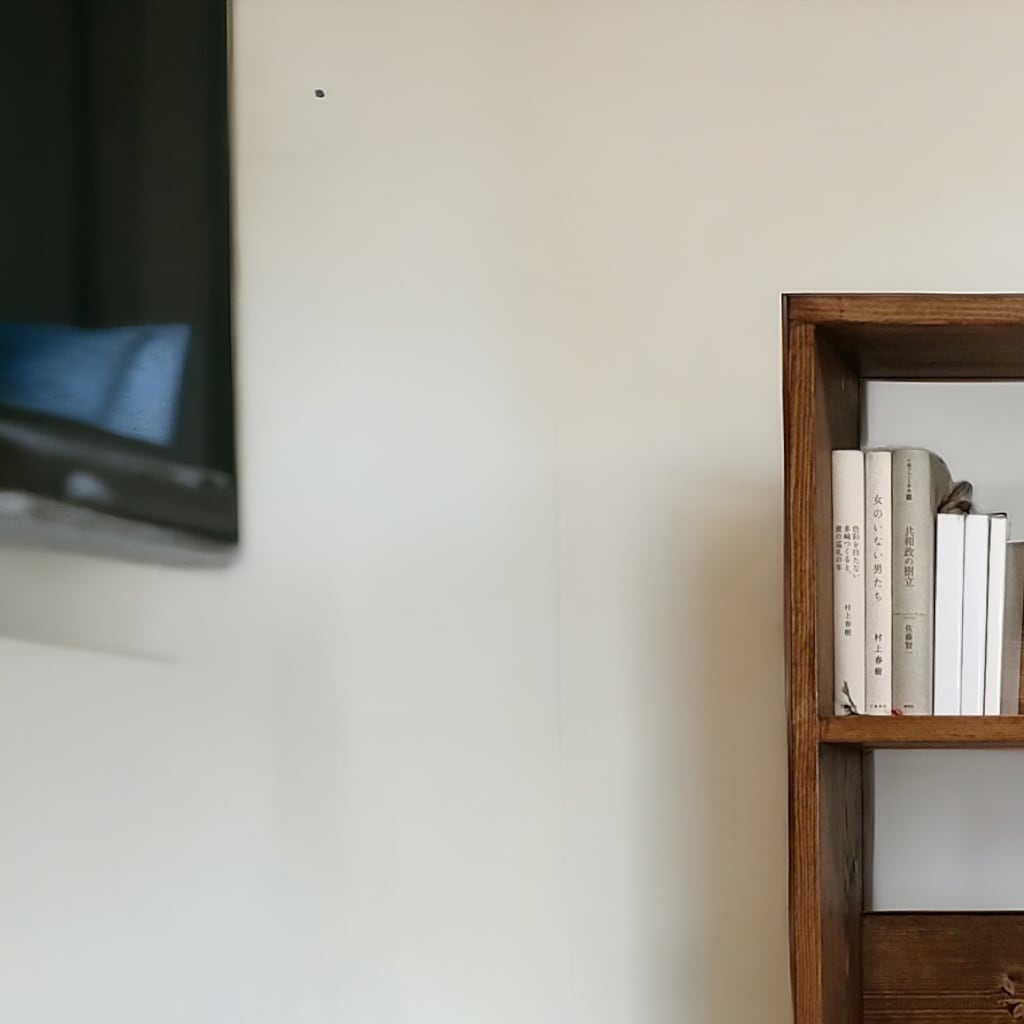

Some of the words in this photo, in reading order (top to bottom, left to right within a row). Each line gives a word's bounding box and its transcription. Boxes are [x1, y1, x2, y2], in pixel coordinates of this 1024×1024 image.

[873, 494, 883, 602] 女のいない男たち
[874, 633, 883, 676] 村上春樹
